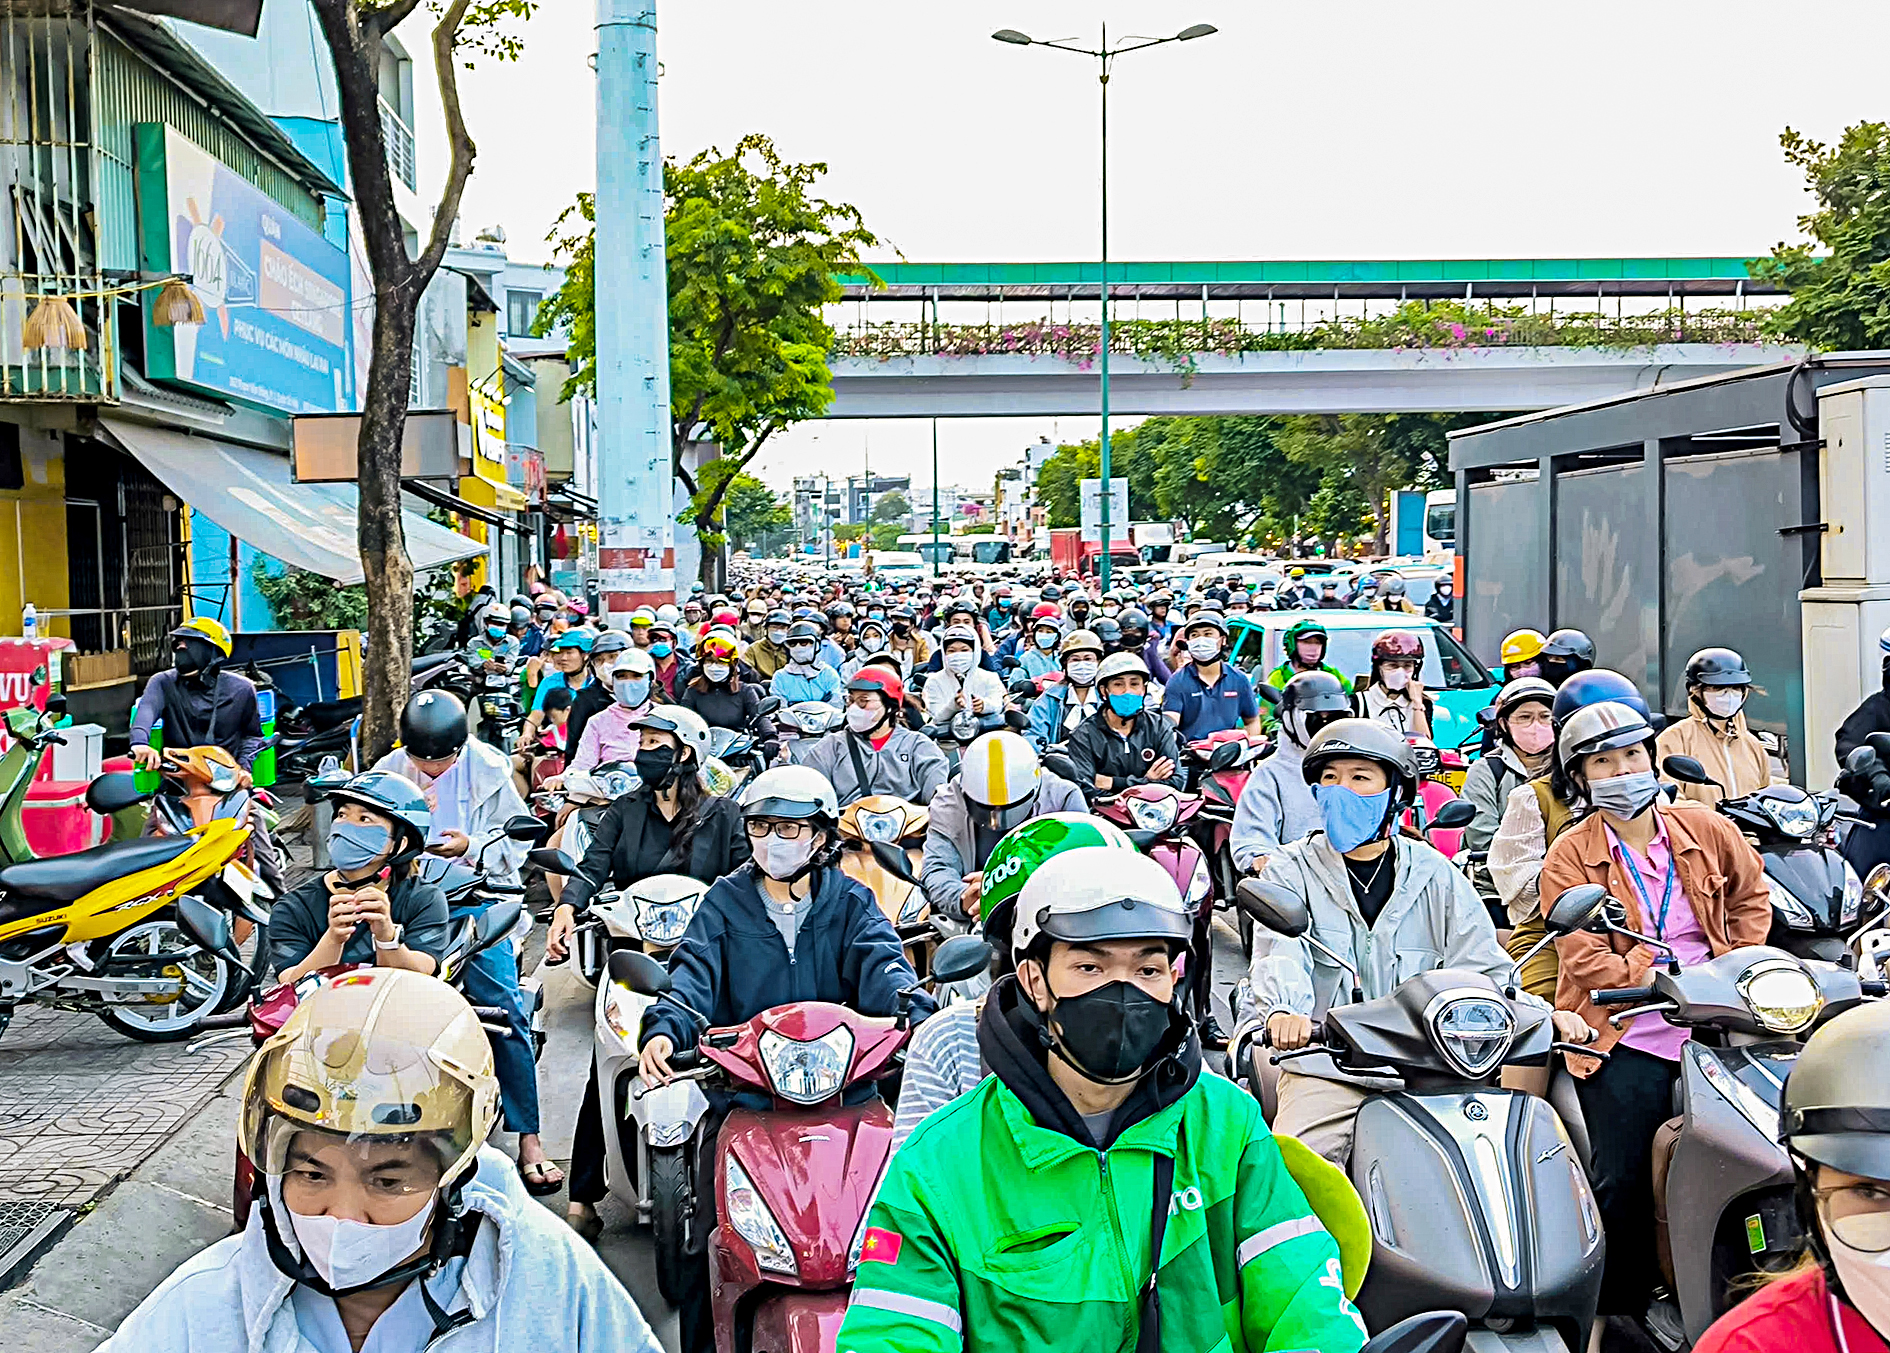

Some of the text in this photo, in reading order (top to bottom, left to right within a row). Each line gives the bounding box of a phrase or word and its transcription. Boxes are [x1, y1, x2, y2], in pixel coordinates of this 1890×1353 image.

[193, 236, 222, 291] 1664
[981, 854, 1022, 896] Grab
[36, 914, 67, 924] SUZUKI
